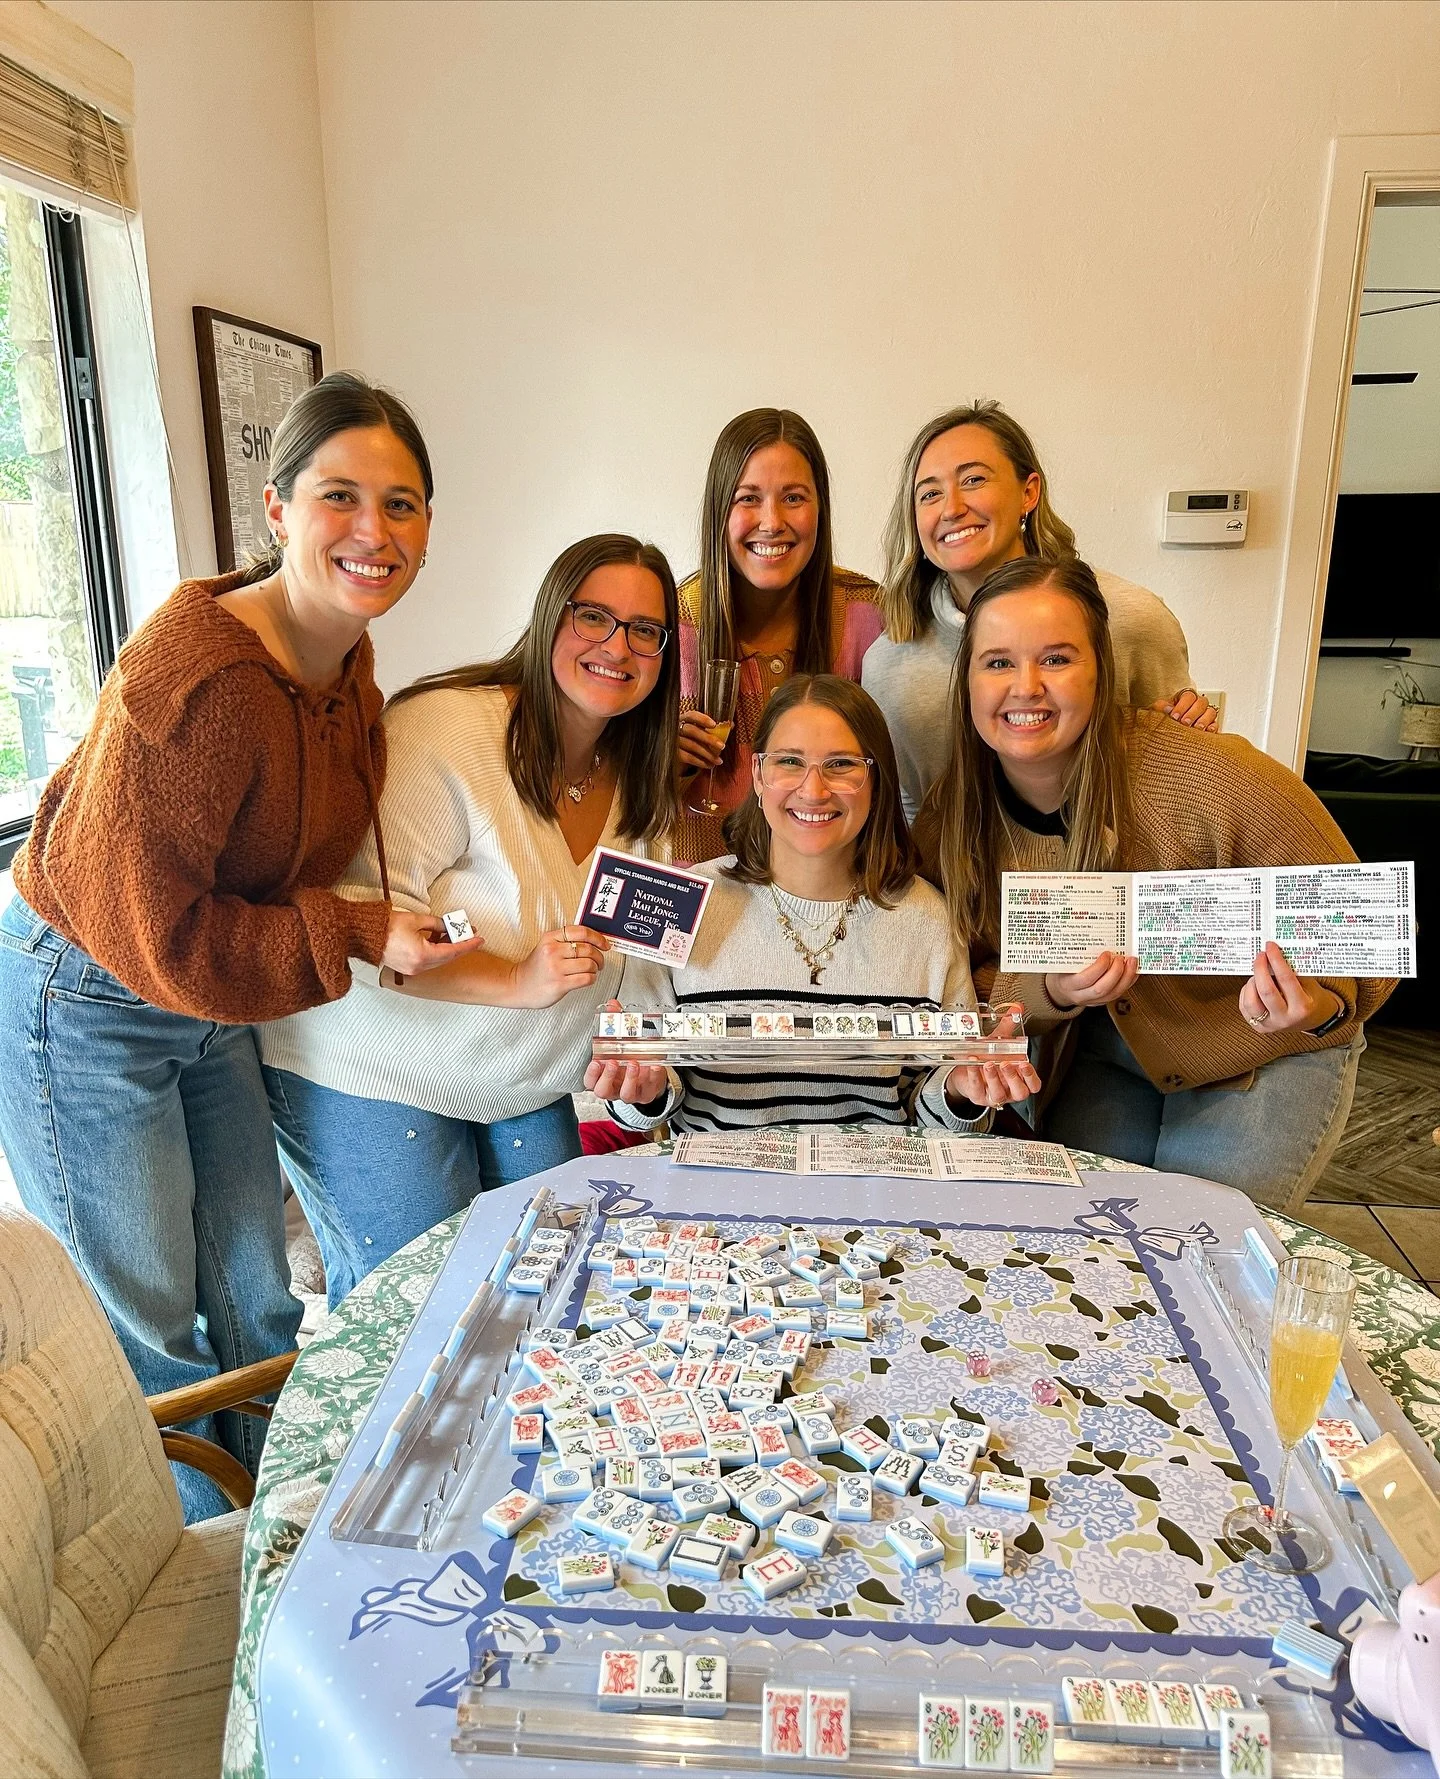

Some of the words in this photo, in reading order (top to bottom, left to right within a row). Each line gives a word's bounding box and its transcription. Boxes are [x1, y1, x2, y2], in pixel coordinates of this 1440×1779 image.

[232, 331, 245, 347] The
[248, 337, 271, 355] Chicago
[242, 424, 276, 462] SHO
[634, 889, 674, 908] NATIONAL
[631, 899, 651, 912] MAH
[652, 905, 679, 920] JONGG
[757, 1556, 794, 1581] E
[644, 1686, 679, 1694] JOKER
[925, 1702, 932, 1713] 8
[970, 1703, 976, 1715] 8
[1014, 1706, 1021, 1718] 8
